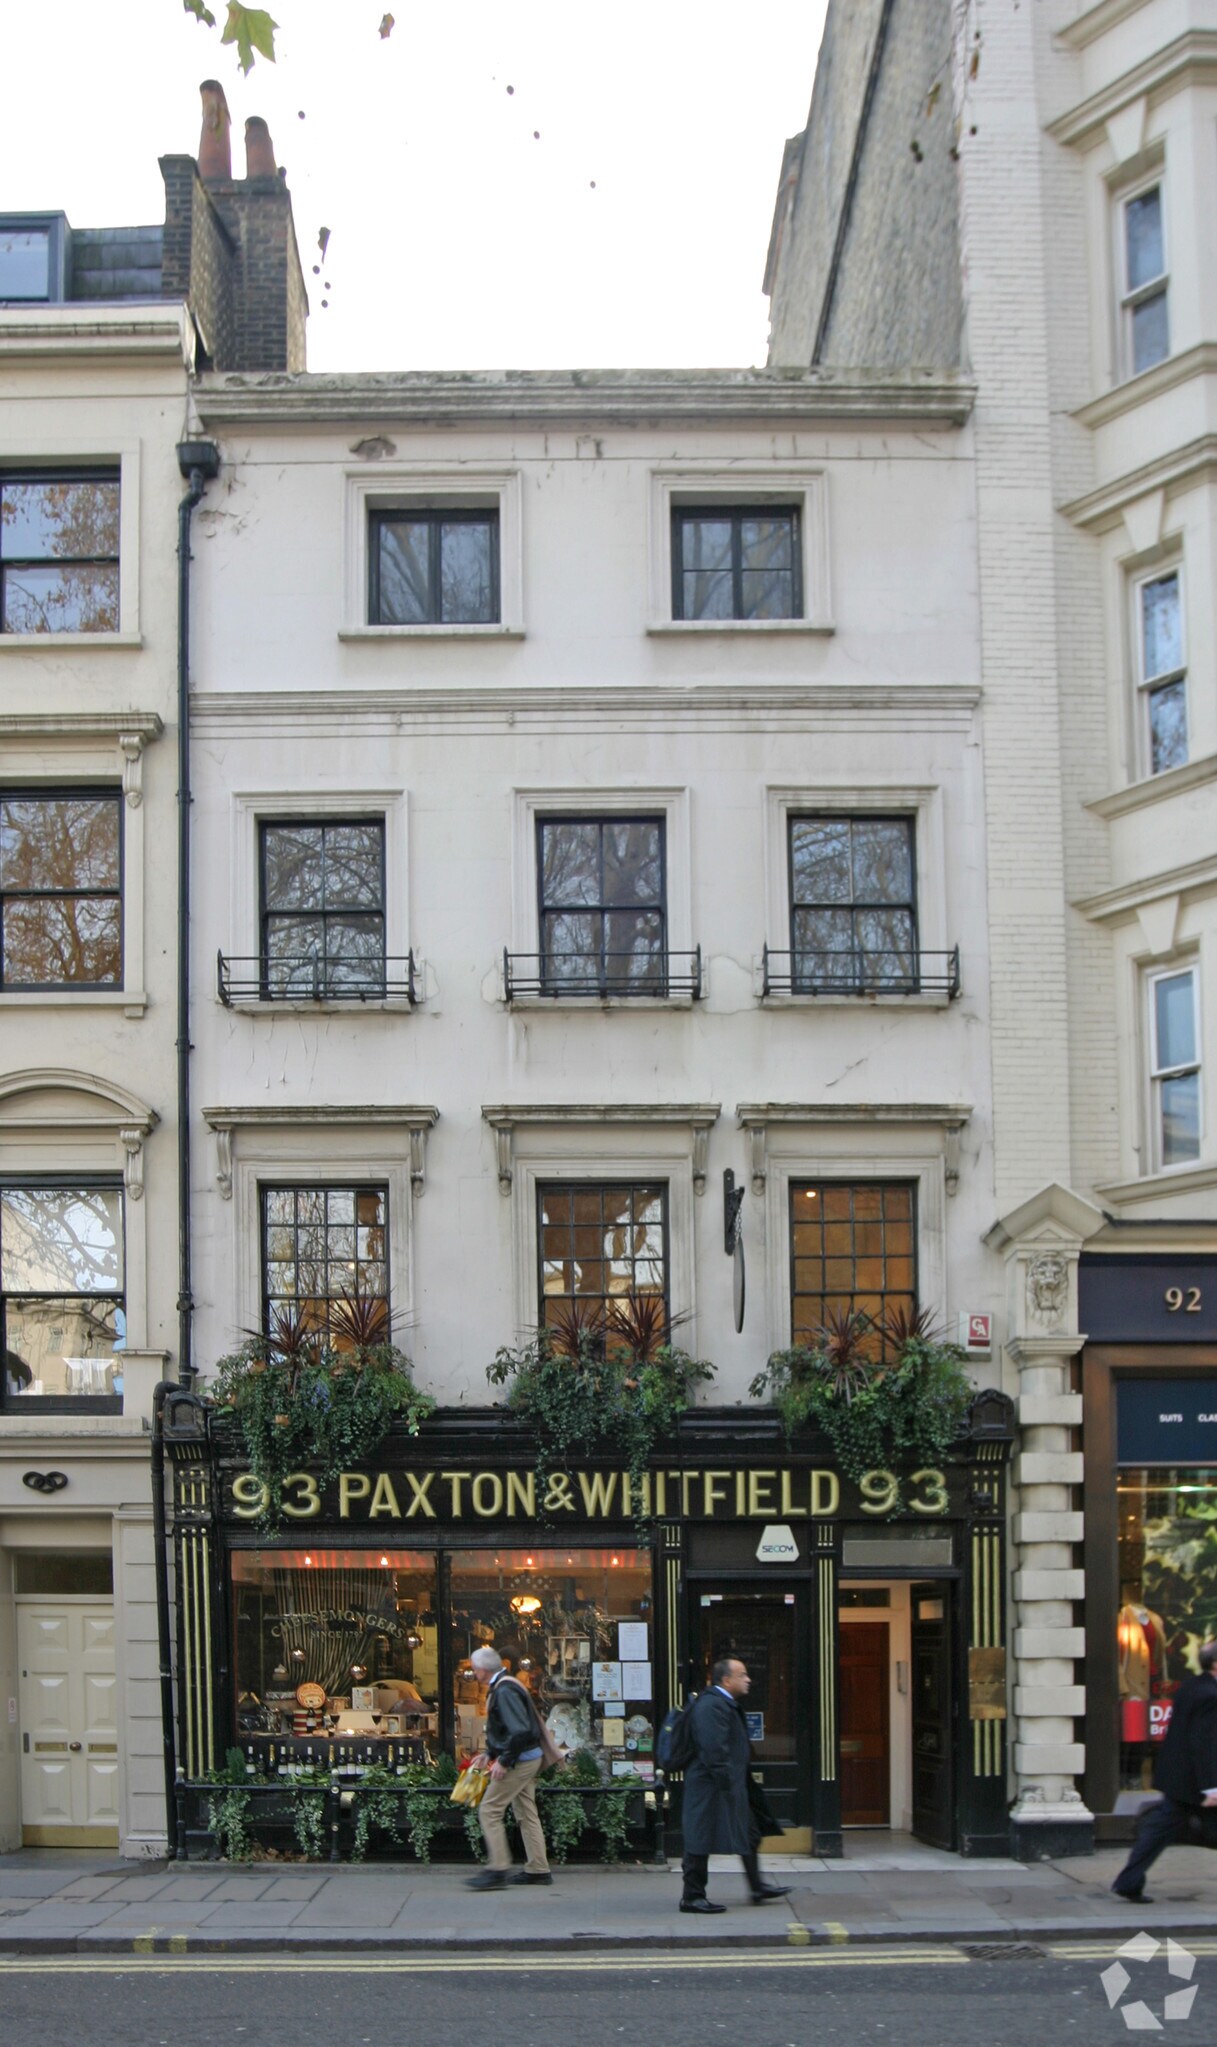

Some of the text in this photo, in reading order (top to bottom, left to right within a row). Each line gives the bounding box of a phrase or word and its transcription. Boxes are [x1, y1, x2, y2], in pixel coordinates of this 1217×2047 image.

[1164, 1287, 1202, 1311] 92
[1159, 1413, 1183, 1423] SUITS
[232, 1469, 949, 1518] 93 PAXTON & WHITFIELD 93
[762, 1545, 794, 1553] SECOM
[271, 1610, 406, 1640] CHEESEMONGERS
[311, 1630, 342, 1639] SINCE
